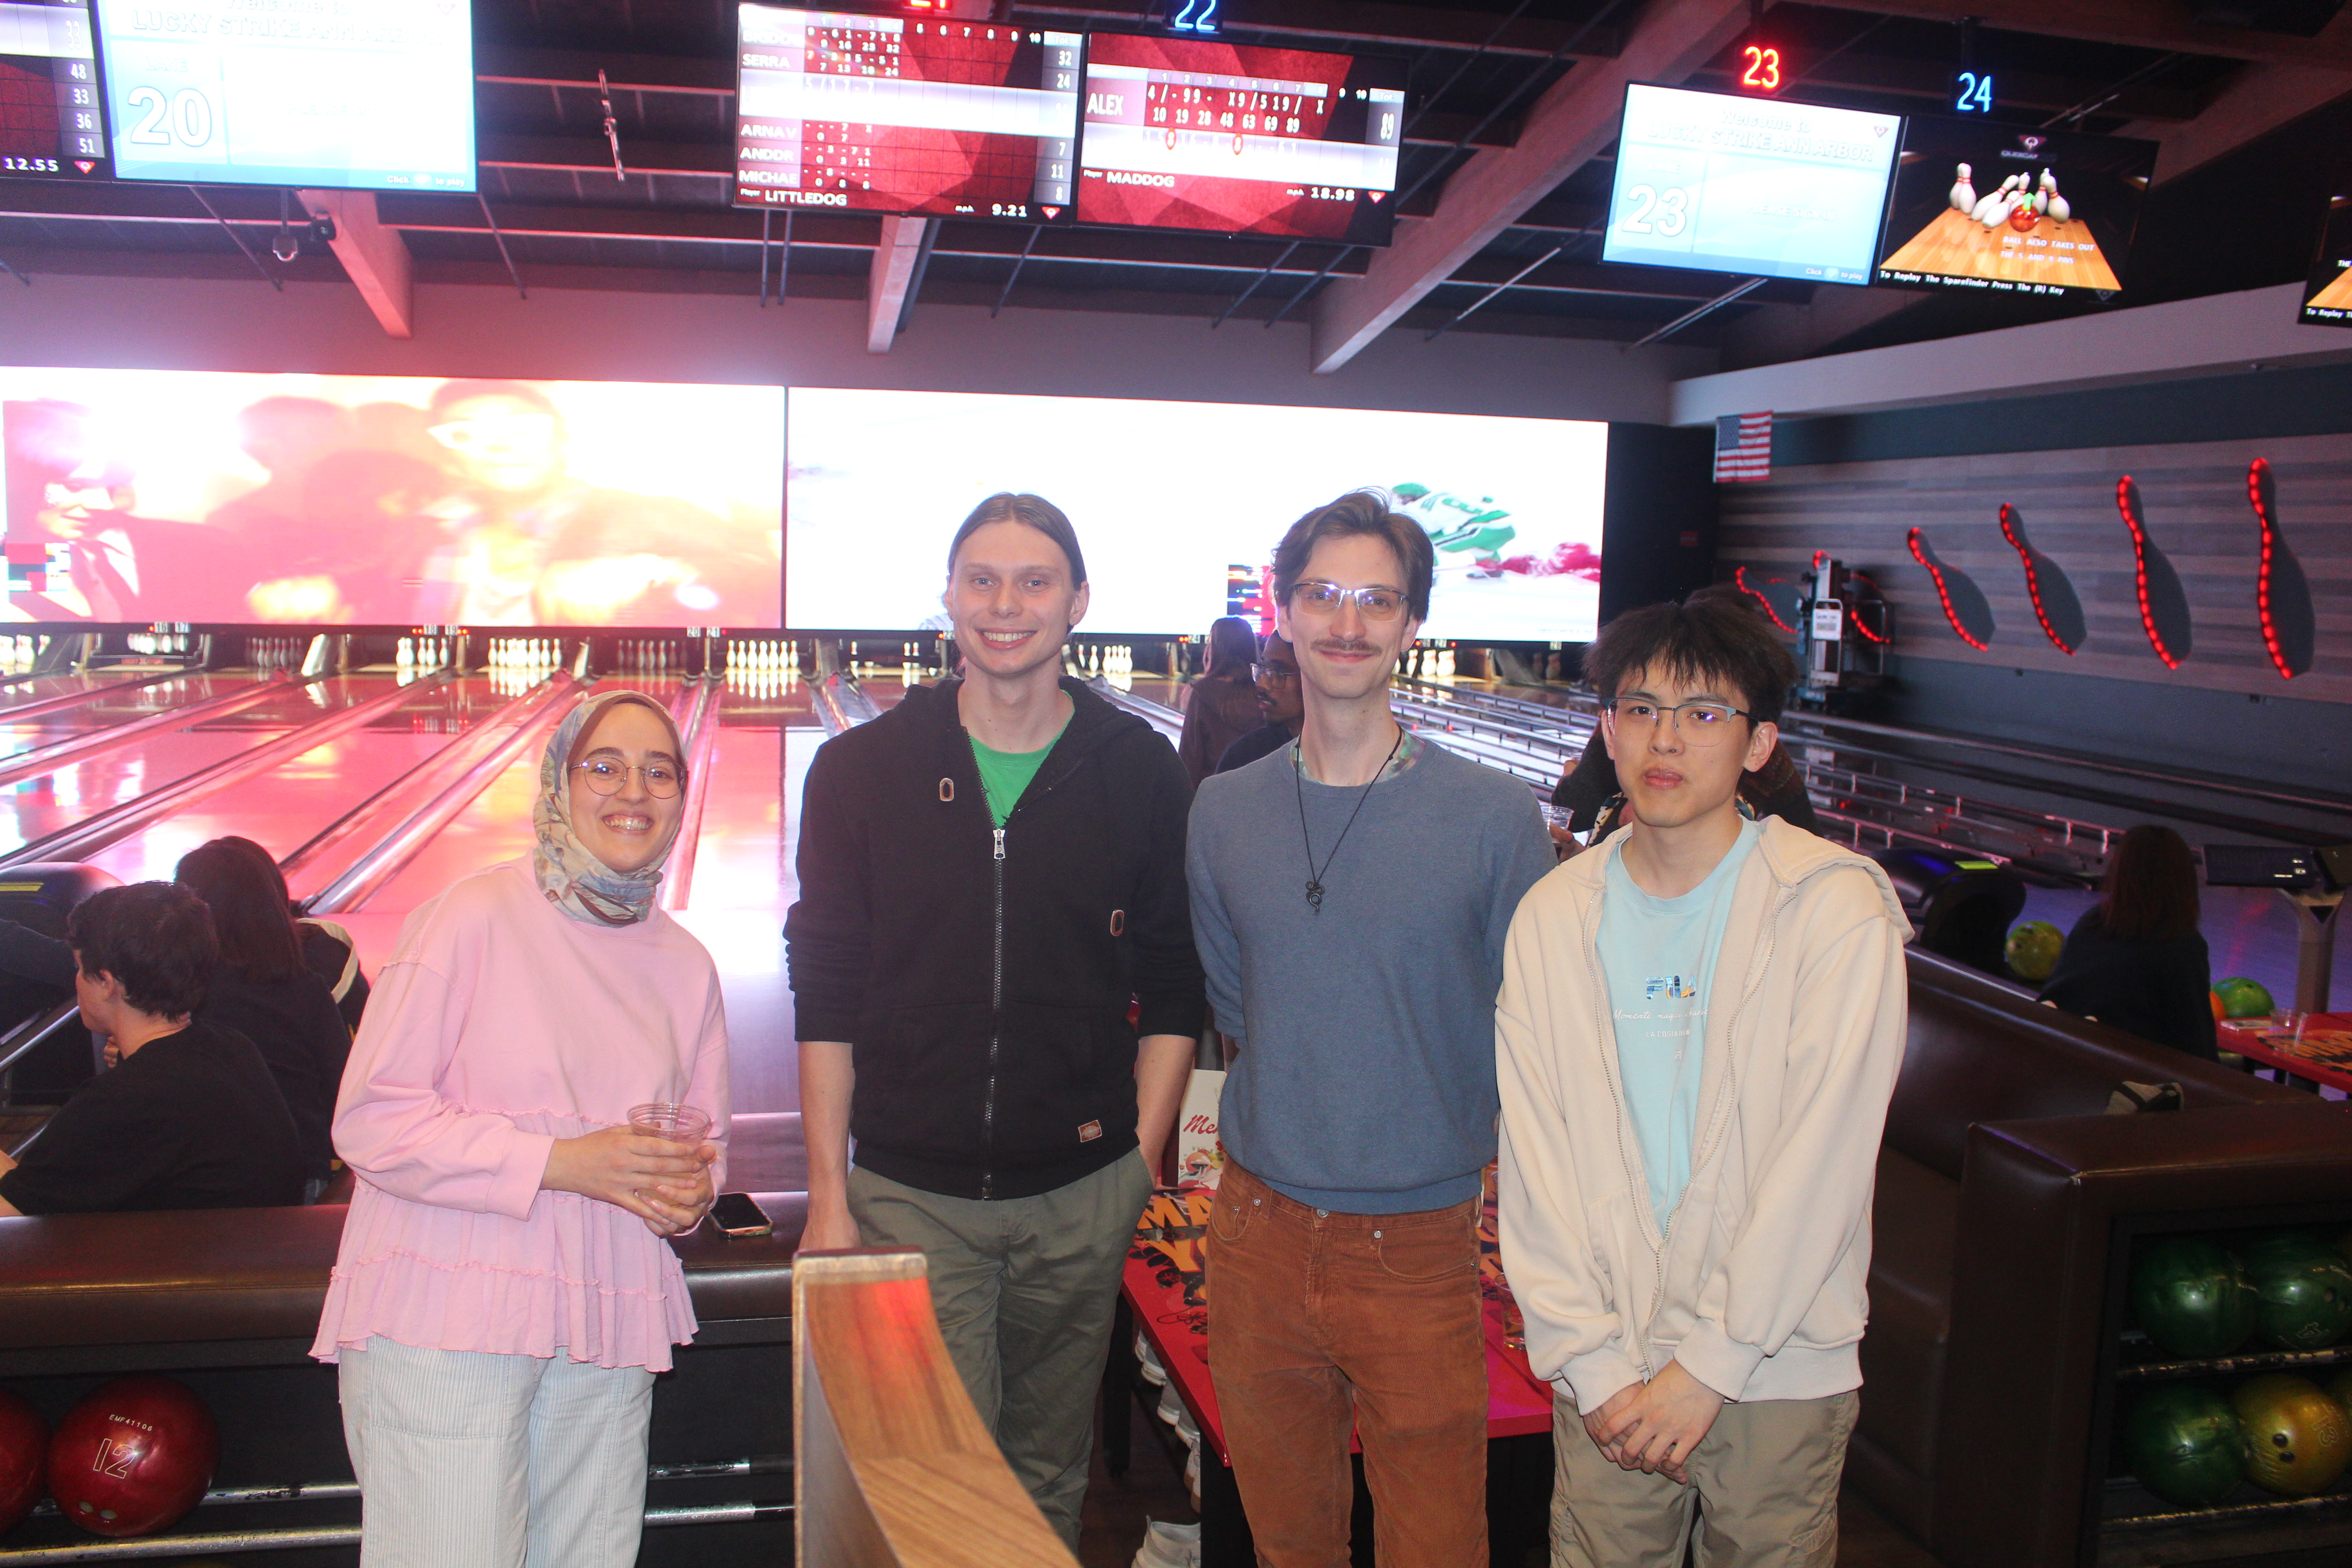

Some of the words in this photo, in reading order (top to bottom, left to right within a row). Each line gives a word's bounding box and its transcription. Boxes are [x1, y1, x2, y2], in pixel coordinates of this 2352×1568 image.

[132, 9, 211, 33] LUCKY
[218, 15, 302, 39] STRIKE
[305, 18, 356, 41] ANN
[821, 16, 827, 25] 1
[845, 18, 851, 27] 2
[868, 20, 875, 29] 3
[892, 21, 899, 30] 4
[916, 23, 924, 34] 5
[940, 25, 947, 36] 6
[963, 27, 970, 37] 7
[987, 29, 995, 39] 8
[1010, 30, 1019, 41] 9
[1029, 32, 1041, 43] 10
[145, 56, 188, 73] LANE
[742, 54, 790, 68] SERRA
[1058, 50, 1072, 66] 32
[70, 64, 87, 80] 48
[1742, 46, 1780, 88] 23
[1057, 73, 1070, 89] 24
[1162, 72, 1167, 82] 1
[1184, 74, 1191, 83] 2
[1206, 76, 1213, 85] 3
[1228, 78, 1235, 87] 4
[1251, 80, 1258, 89] 5
[1273, 82, 1279, 91] 6
[1295, 84, 1301, 93] 7
[1339, 88, 1346, 98] 9
[1356, 89, 1367, 100] 10
[73, 88, 90, 105] 33
[1957, 72, 1993, 113] 24
[1087, 93, 1124, 116] ALEX
[76, 113, 93, 130] 36
[127, 86, 212, 148] 20
[1153, 107, 1166, 122] 10
[1176, 108, 1189, 124] 19
[1197, 110, 1211, 126] 28
[1220, 112, 1234, 127] 48
[1242, 114, 1255, 129] 63
[1264, 115, 1278, 131] 69
[1286, 117, 1300, 133] 89
[1380, 113, 1394, 140] 89
[1720, 107, 1791, 132] Welcome
[1795, 117, 1813, 133] to
[78, 137, 95, 154] 51
[1059, 142, 1066, 156] 7
[1647, 120, 1708, 142] LUCKY
[1710, 127, 1771, 151] STRIKE
[1772, 136, 1812, 155] ANN
[1813, 140, 1873, 162] ARBOR
[740, 147, 794, 161] ANDDR
[3, 157, 59, 172] 12.55
[1051, 164, 1064, 179] 11
[1648, 161, 1681, 173] LANE
[387, 175, 410, 185] Click
[435, 177, 446, 186] to
[447, 177, 466, 188] play
[739, 170, 798, 185] MICHAE
[1107, 171, 1175, 187] MADDOG
[765, 189, 848, 206] LITTLEDOG
[1056, 186, 1063, 201] 8
[1311, 187, 1355, 201] 18.98
[992, 203, 1028, 218] 9.21
[1621, 184, 1690, 238] 23
[1745, 202, 1791, 216] PLEASE
[1793, 207, 1836, 221] SIGN-IN
[2003, 236, 2022, 245] BALL
[2026, 238, 2047, 247] ALSO
[2051, 240, 2075, 250] TAKES
[2078, 243, 2095, 252] OUT
[2058, 256, 2075, 264] PINS
[1806, 268, 1823, 276] Click
[1849, 273, 1864, 281] play
[1880, 271, 1891, 279] To
[1894, 272, 1921, 283] Replay
[1926, 274, 1940, 284] The
[1943, 276, 1989, 288] Sparefinder
[1992, 280, 2013, 290] Press
[2017, 283, 2032, 292] The
[2034, 284, 2047, 294] (R)
[2048, 286, 2065, 296] Key
[2318, 309, 2343, 318] Replay
[1646, 974, 1697, 999] FILA
[109, 1414, 153, 1431] EMF41106
[93, 1438, 136, 1479] 12
